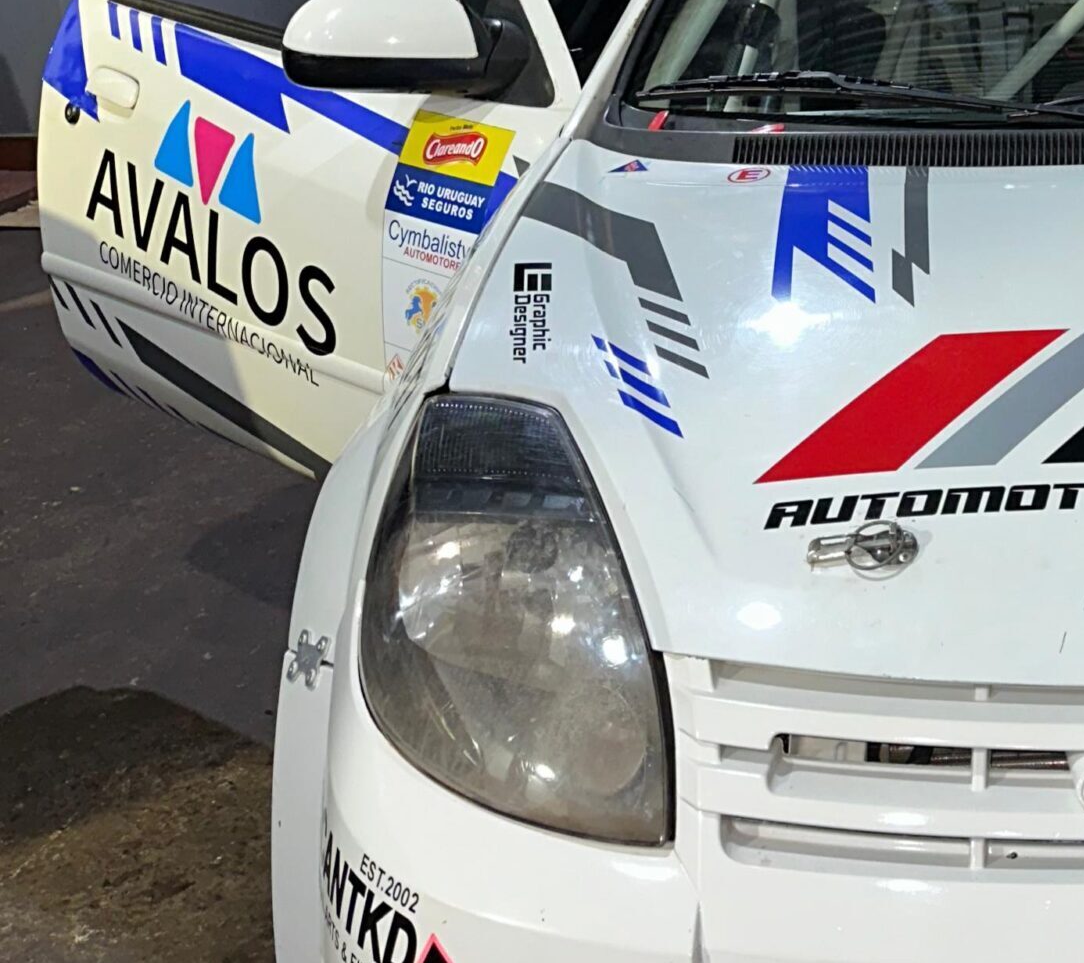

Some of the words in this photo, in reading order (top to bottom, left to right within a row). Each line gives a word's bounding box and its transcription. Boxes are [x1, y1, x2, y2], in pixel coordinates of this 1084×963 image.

[417, 181, 435, 196] RIO
[436, 186, 486, 208] URUGUAY
[421, 197, 474, 221] SEGUROS
[85, 147, 337, 357] AVALOS
[388, 219, 471, 260] Cymbalisty
[403, 246, 461, 271] AUTOMOTORE
[99, 240, 178, 306] COMERCIO
[178, 291, 320, 387] INTERNACIONAL
[509, 293, 532, 364] Designer
[529, 293, 552, 351] Graphic
[359, 853, 420, 914] EST.2002
